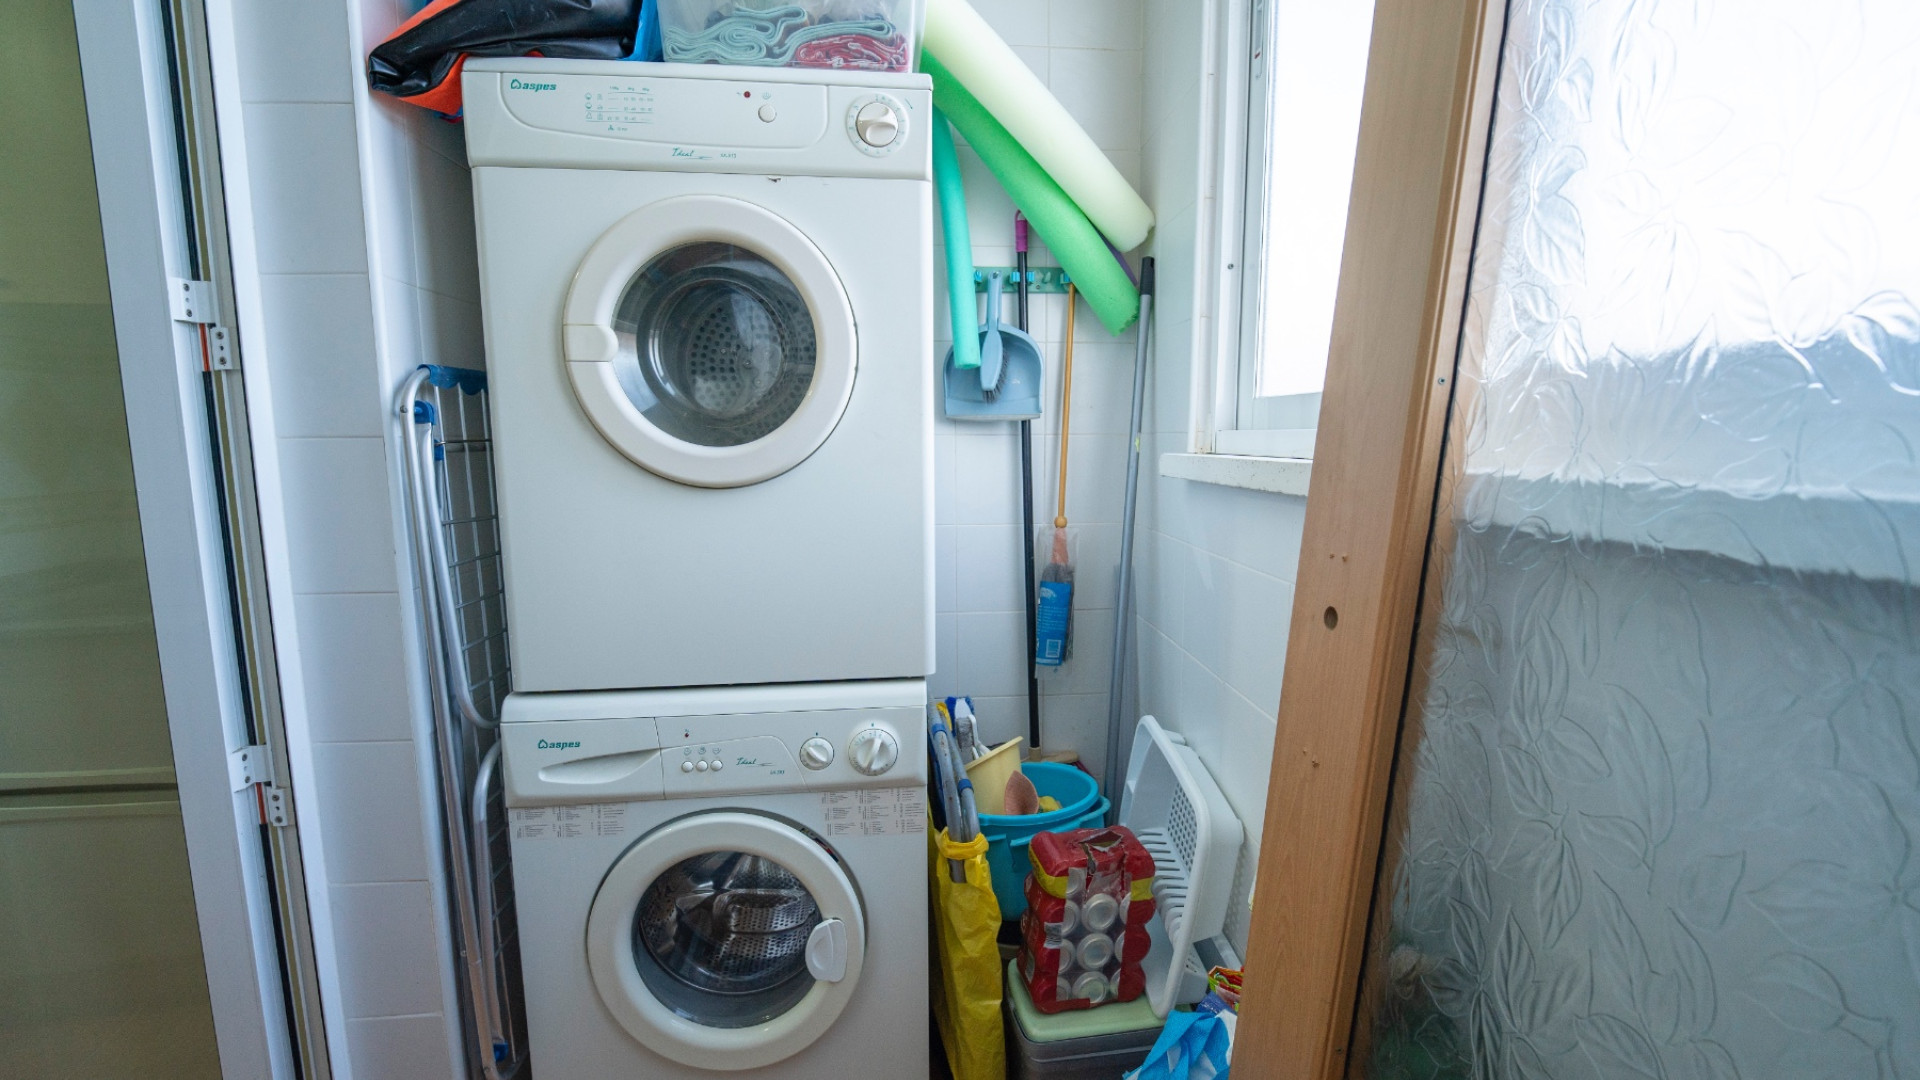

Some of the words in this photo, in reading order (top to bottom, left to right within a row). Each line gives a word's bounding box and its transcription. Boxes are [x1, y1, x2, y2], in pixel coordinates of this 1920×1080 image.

[522, 83, 557, 92] aspes
[672, 147, 694, 157] Ideal
[549, 741, 581, 751] aspes
[736, 757, 757, 766] Ideal
